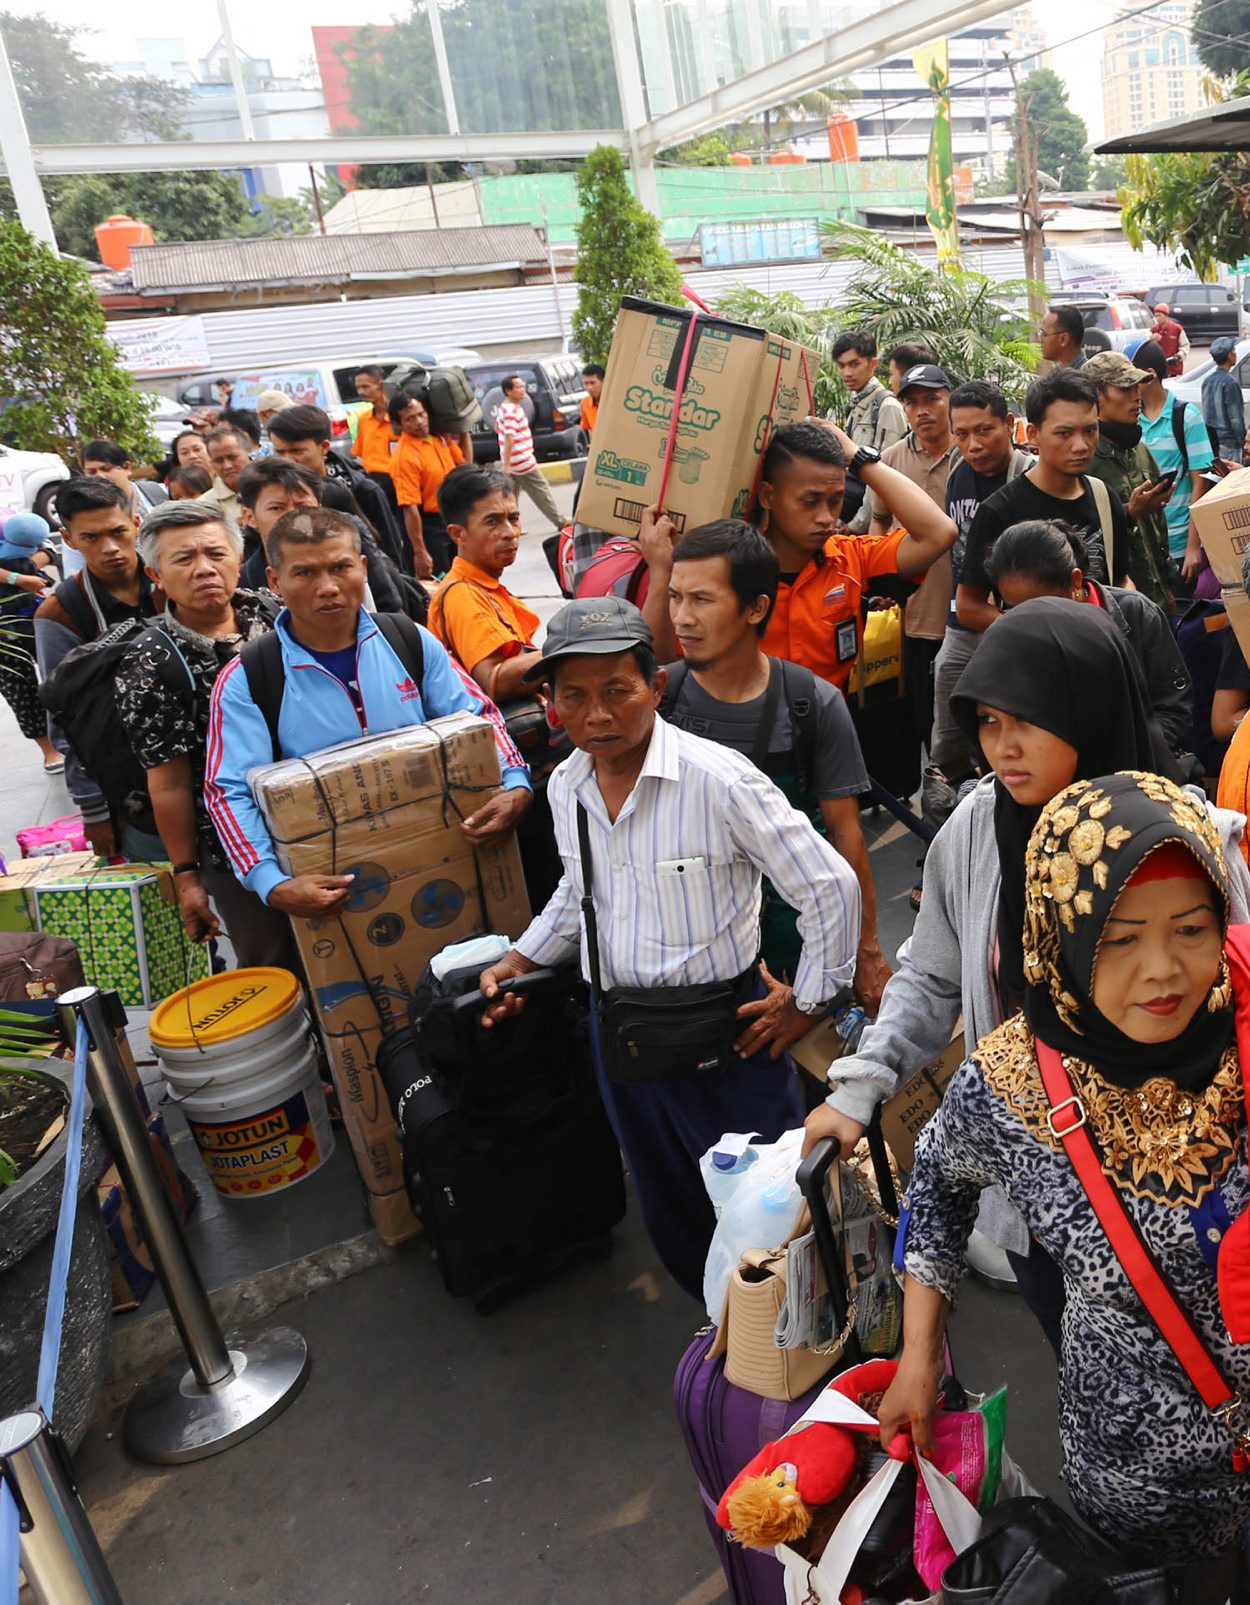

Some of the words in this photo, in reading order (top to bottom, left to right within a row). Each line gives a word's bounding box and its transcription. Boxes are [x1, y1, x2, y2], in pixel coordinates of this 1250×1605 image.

[600, 450, 619, 470] XL
[340, 1047, 365, 1105] Maspion
[404, 1074, 433, 1100] POLO
[899, 1098, 924, 1124] EDO
[217, 1114, 287, 1147] JOTUN
